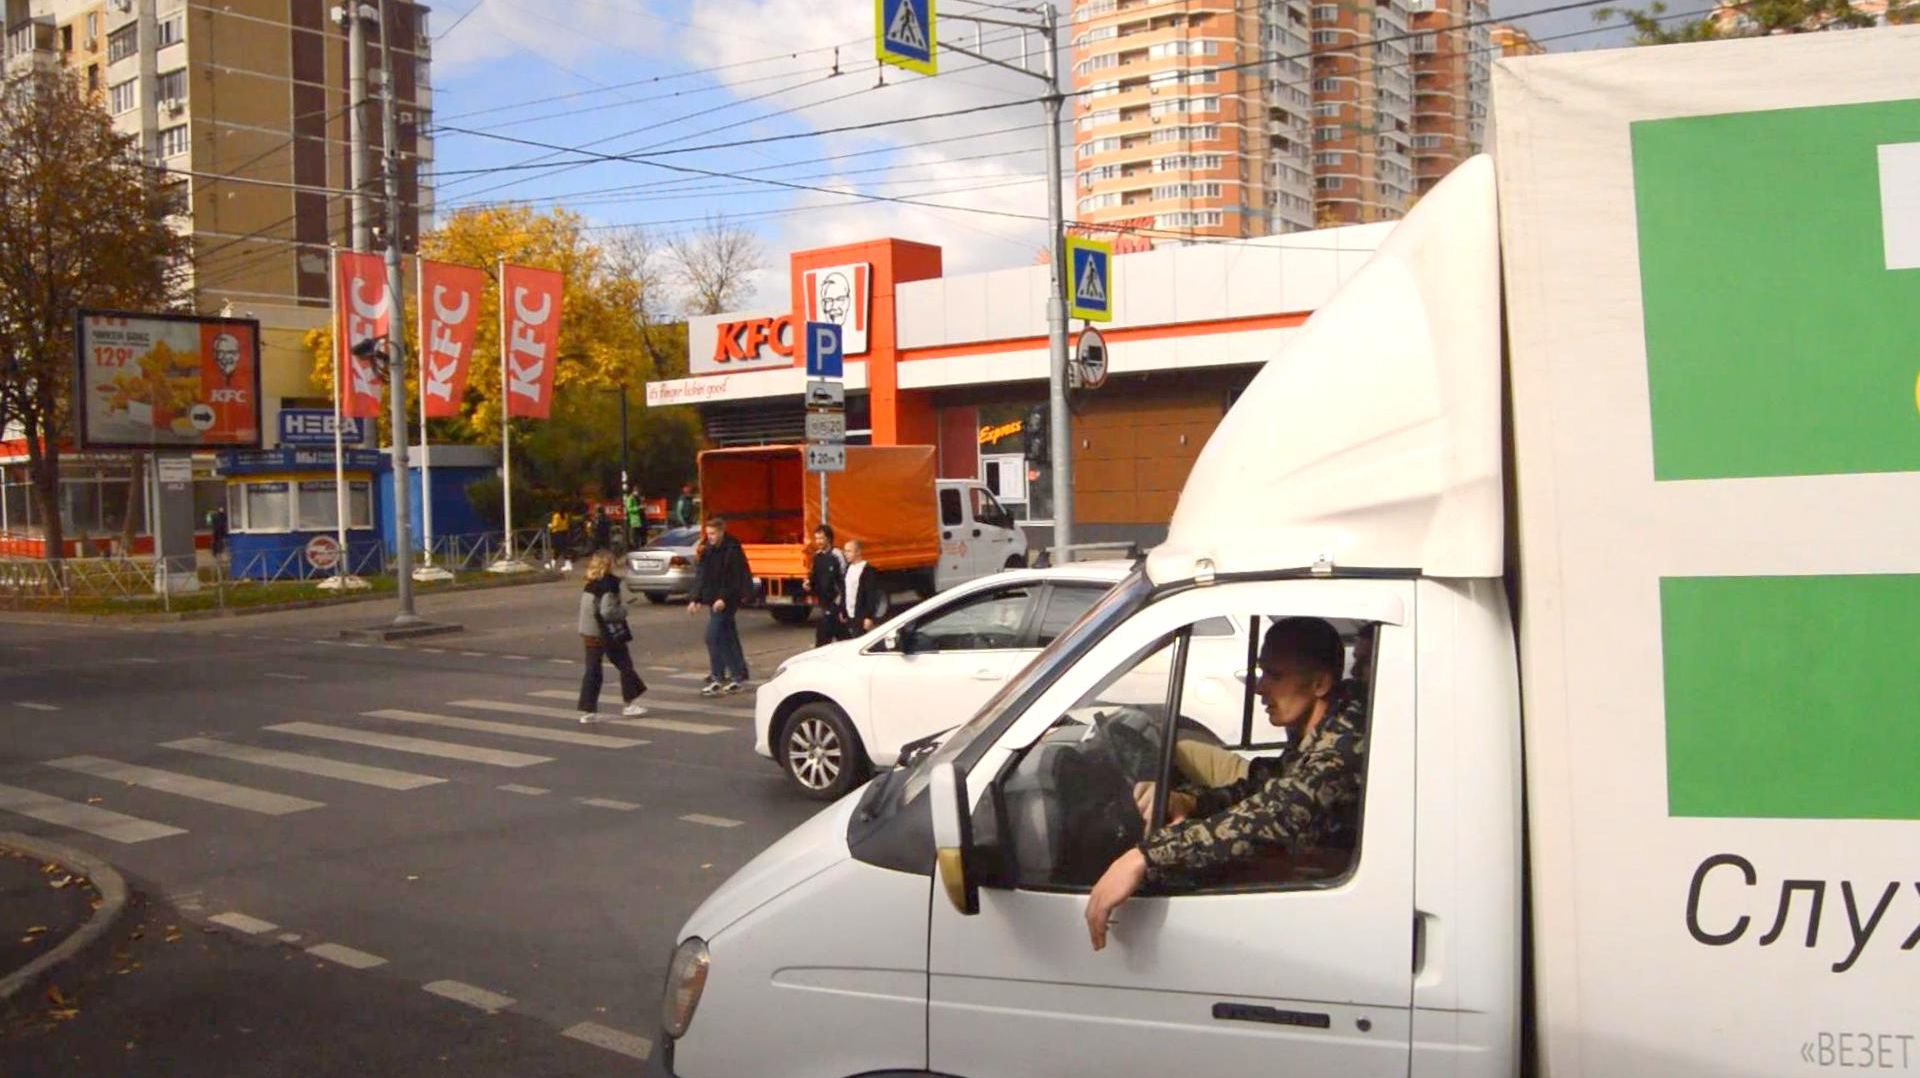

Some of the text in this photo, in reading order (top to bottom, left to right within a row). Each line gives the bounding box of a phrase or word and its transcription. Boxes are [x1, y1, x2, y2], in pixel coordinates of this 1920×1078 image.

[351, 277, 390, 400] KFC
[427, 285, 469, 402] KFC
[509, 286, 551, 402] KFC
[713, 315, 794, 363] KFC
[211, 389, 247, 403] KFC
[979, 420, 1024, 444] Express
